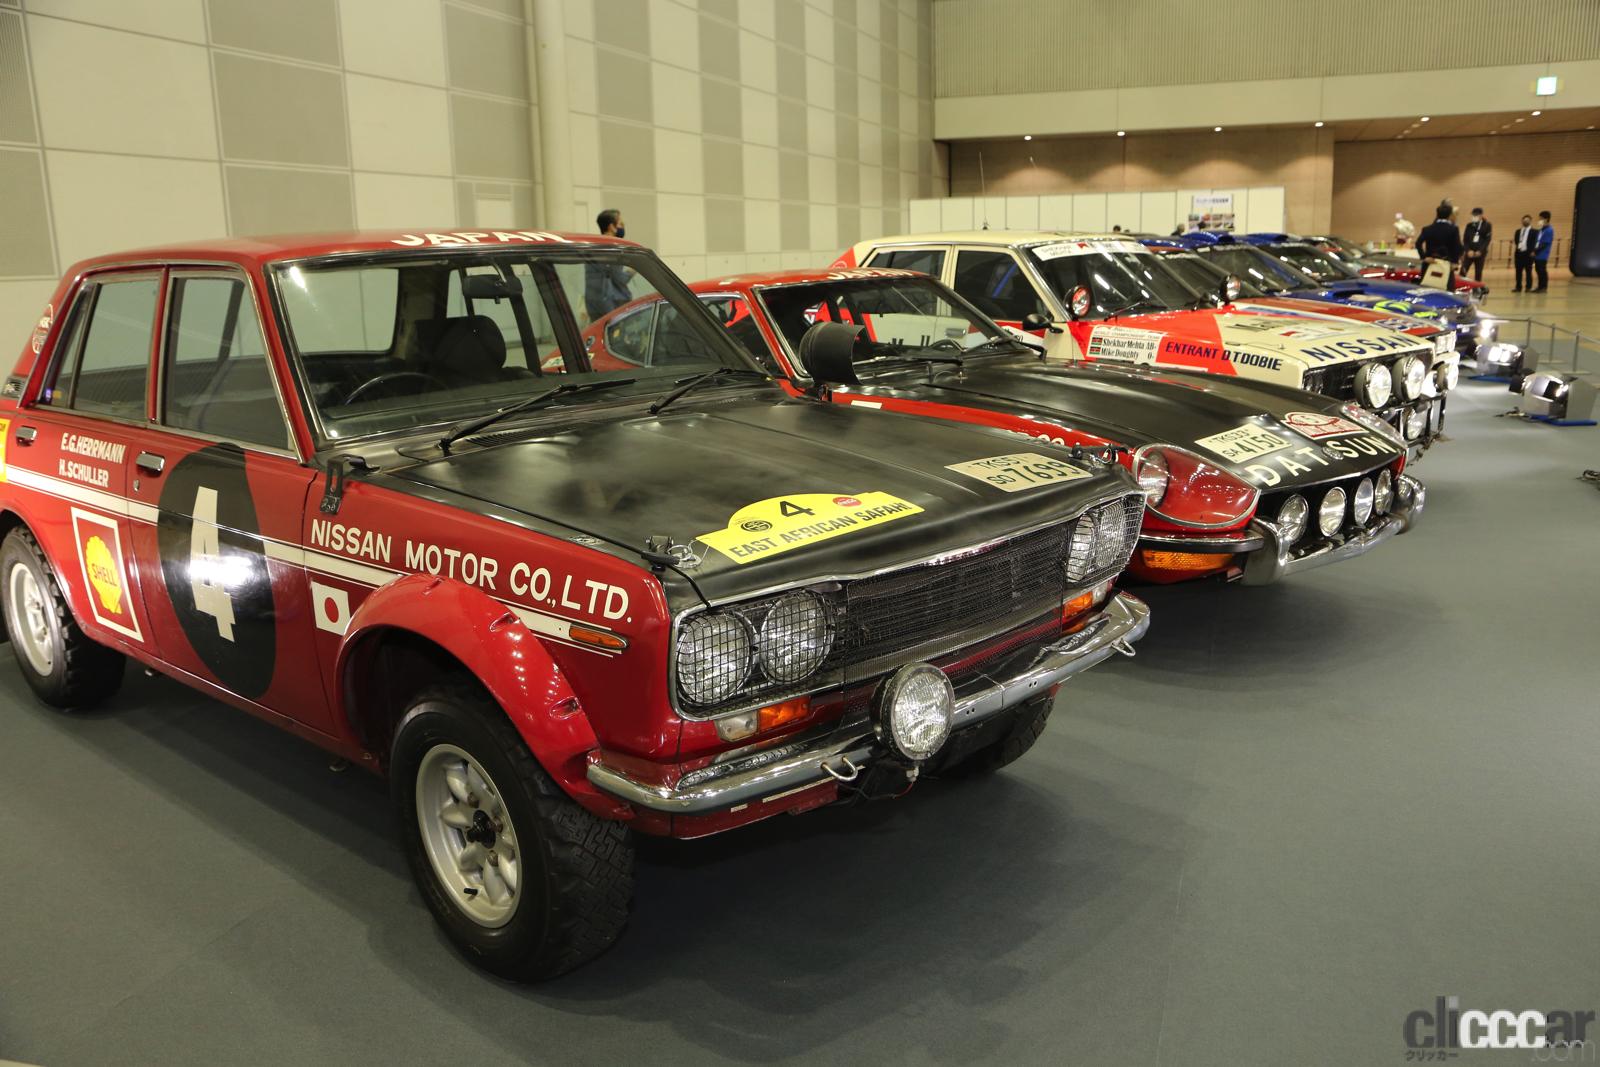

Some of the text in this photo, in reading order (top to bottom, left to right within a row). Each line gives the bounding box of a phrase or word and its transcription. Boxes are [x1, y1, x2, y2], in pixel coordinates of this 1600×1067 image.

[391, 231, 574, 247] JAPAN
[1165, 341, 1219, 359] ENTRANT
[1300, 333, 1420, 362] NISSAN
[1234, 433, 1285, 454] 4150
[1244, 436, 1398, 487] DATSUN
[779, 500, 815, 518] 4
[728, 537, 780, 558] EAST
[780, 515, 858, 544] AFRICAN
[190, 486, 237, 643] 4
[310, 518, 391, 563] NISSAN
[405, 540, 498, 590] MOTOR
[91, 562, 118, 587] SHELL
